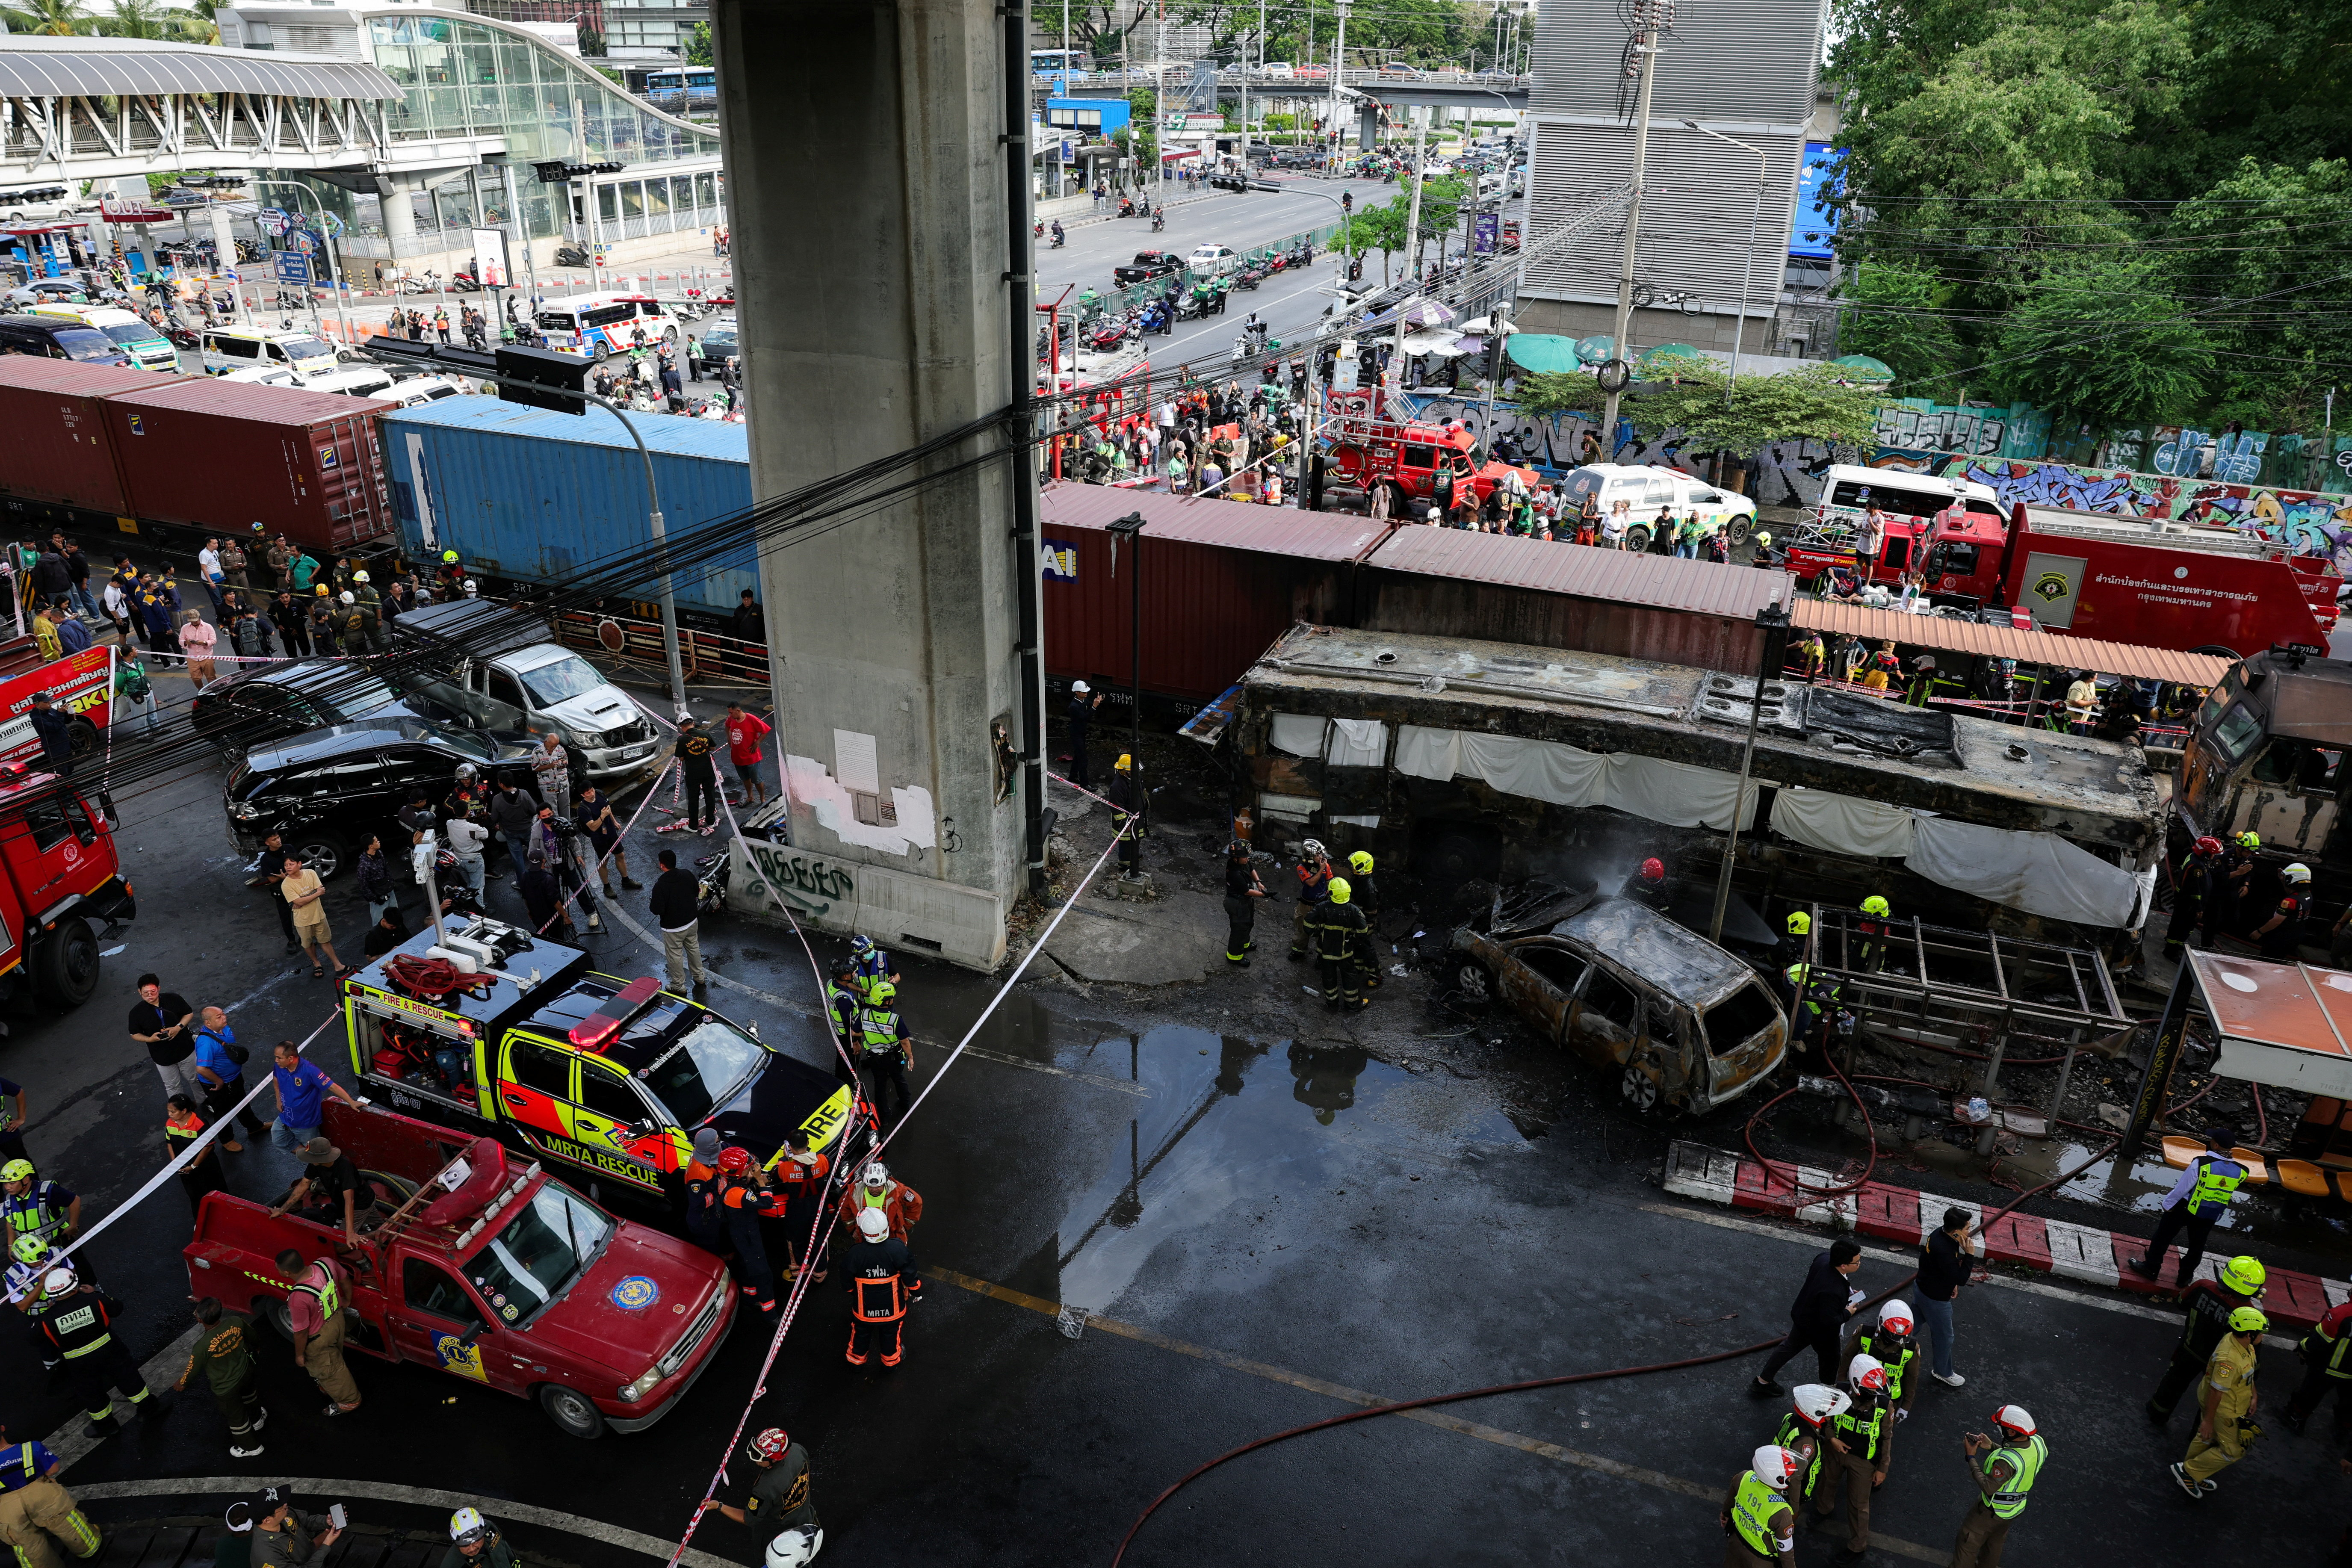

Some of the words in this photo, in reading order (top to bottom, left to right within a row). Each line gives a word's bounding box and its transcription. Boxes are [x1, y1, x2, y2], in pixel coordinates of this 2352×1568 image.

[108, 201, 143, 215] OUT
[276, 254, 282, 264] P
[1078, 411, 1094, 424] รถไฟ
[9, 502, 23, 512] SRT
[1800, 554, 1834, 563] อาสามูลนิธิ
[513, 582, 532, 592] SRT
[2095, 573, 2259, 602] สำนักป้องกันและบรรเทาสาธารณภัย
[2137, 592, 2213, 608] กรุงเทพมหานคร
[1176, 703, 1198, 715] SRT
[19, 742, 42, 755] RESCUE
[383, 993, 401, 1007] FIRE
[404, 998, 409, 1006] &
[413, 1003, 444, 1021] RESCUE
[391, 1089, 414, 1107] กู้ภัย
[414, 1097, 425, 1110] 07
[546, 1135, 593, 1163] MRTA
[596, 1152, 659, 1188] RESCUE
[789, 1168, 824, 1179] RESUE
[866, 1265, 890, 1278] รฟม.
[59, 1307, 91, 1326] กทม.
[867, 1308, 891, 1317] MRTA
[1747, 1492, 1764, 1513] 191
